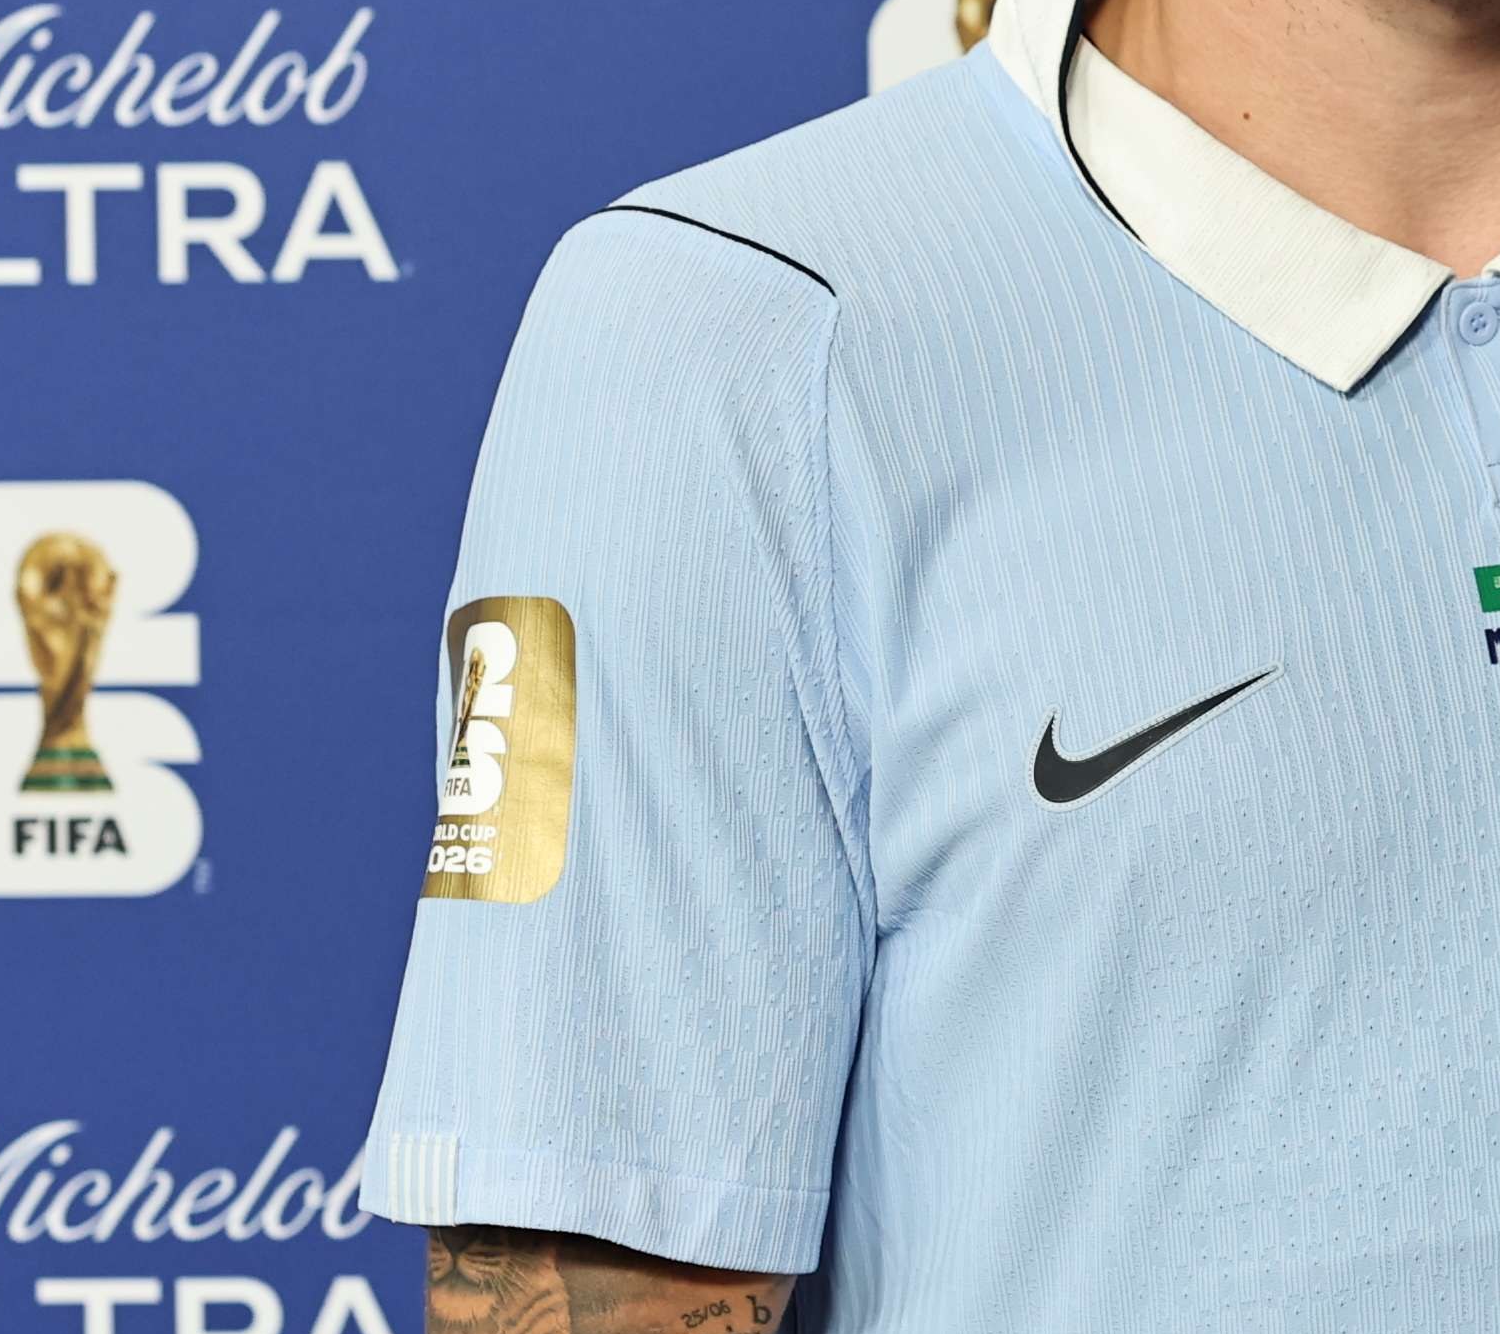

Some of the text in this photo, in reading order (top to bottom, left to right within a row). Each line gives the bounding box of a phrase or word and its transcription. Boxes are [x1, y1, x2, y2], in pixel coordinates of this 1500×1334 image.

[13, 817, 128, 856] FIFA
[459, 823, 498, 843] CUP
[426, 844, 494, 876] 026
